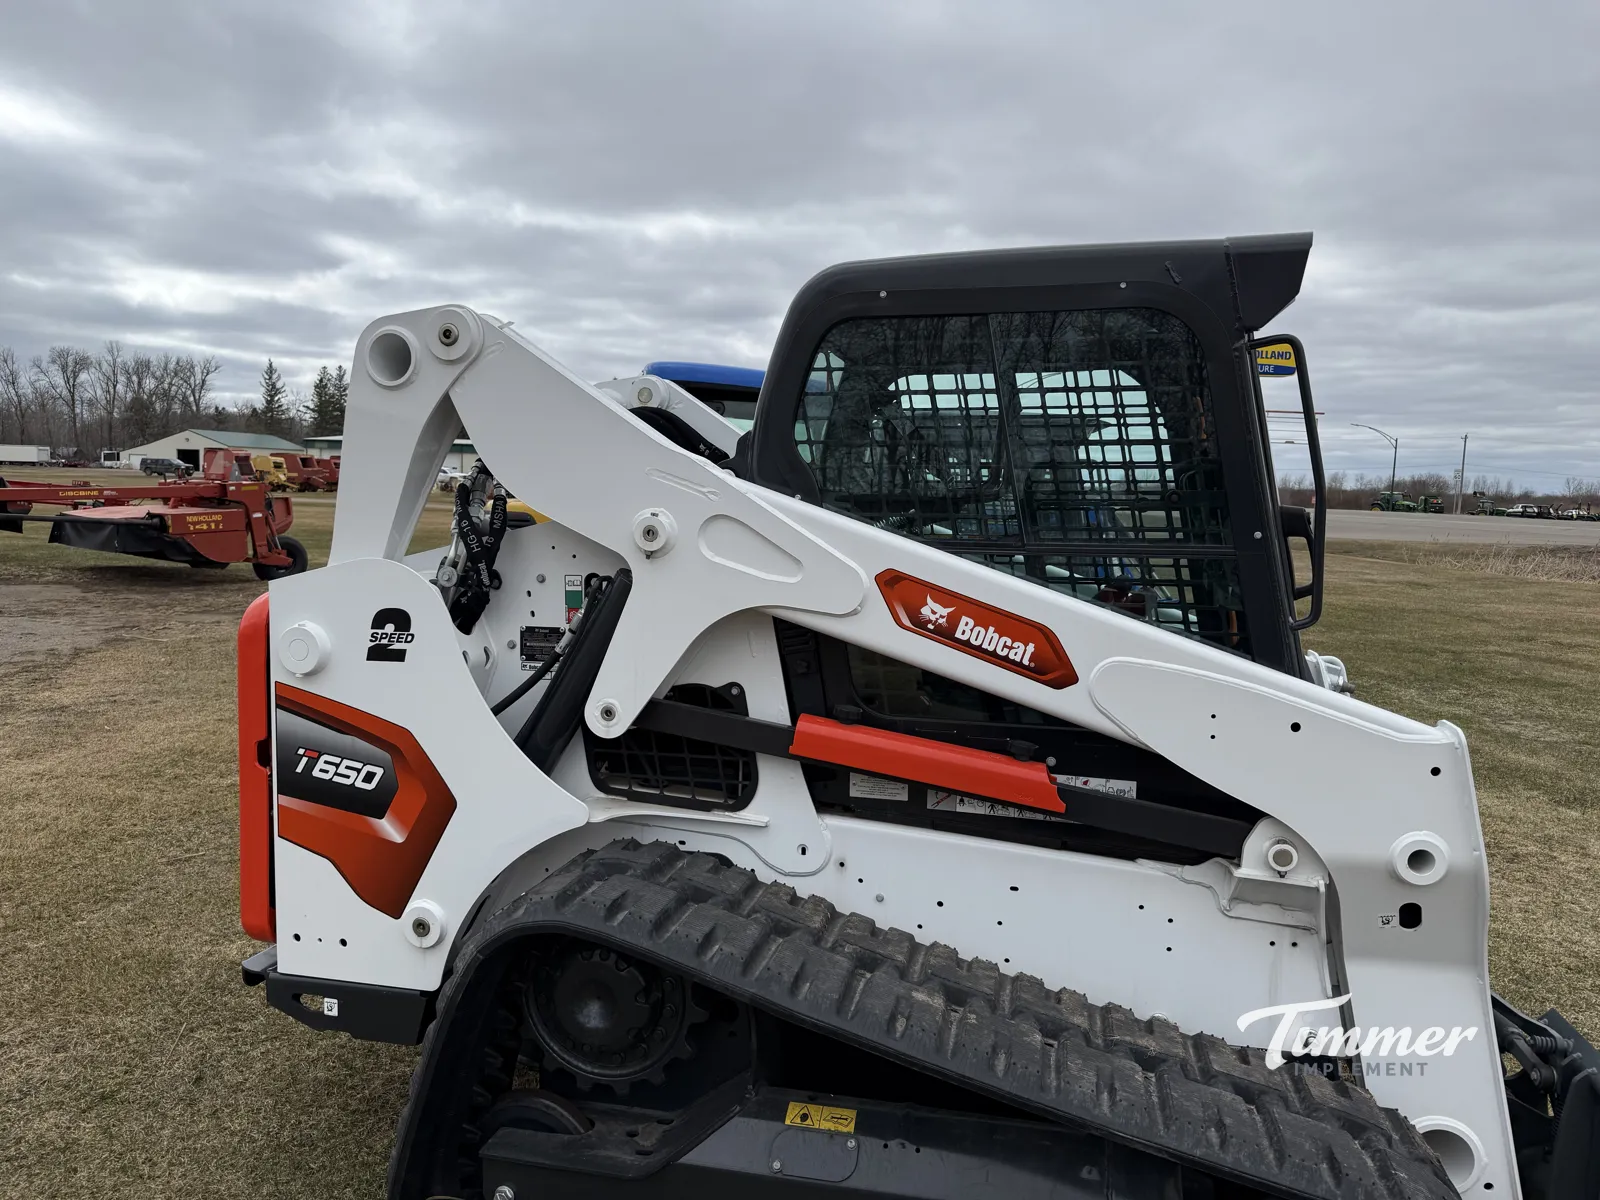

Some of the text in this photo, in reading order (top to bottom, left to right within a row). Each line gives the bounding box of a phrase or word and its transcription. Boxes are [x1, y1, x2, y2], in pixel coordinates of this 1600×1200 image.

[199, 514, 223, 522] HOLLAND
[366, 607, 412, 662] 2
[369, 631, 415, 644] SPEED
[954, 615, 1036, 667] Bobcat
[295, 747, 385, 791] T650
